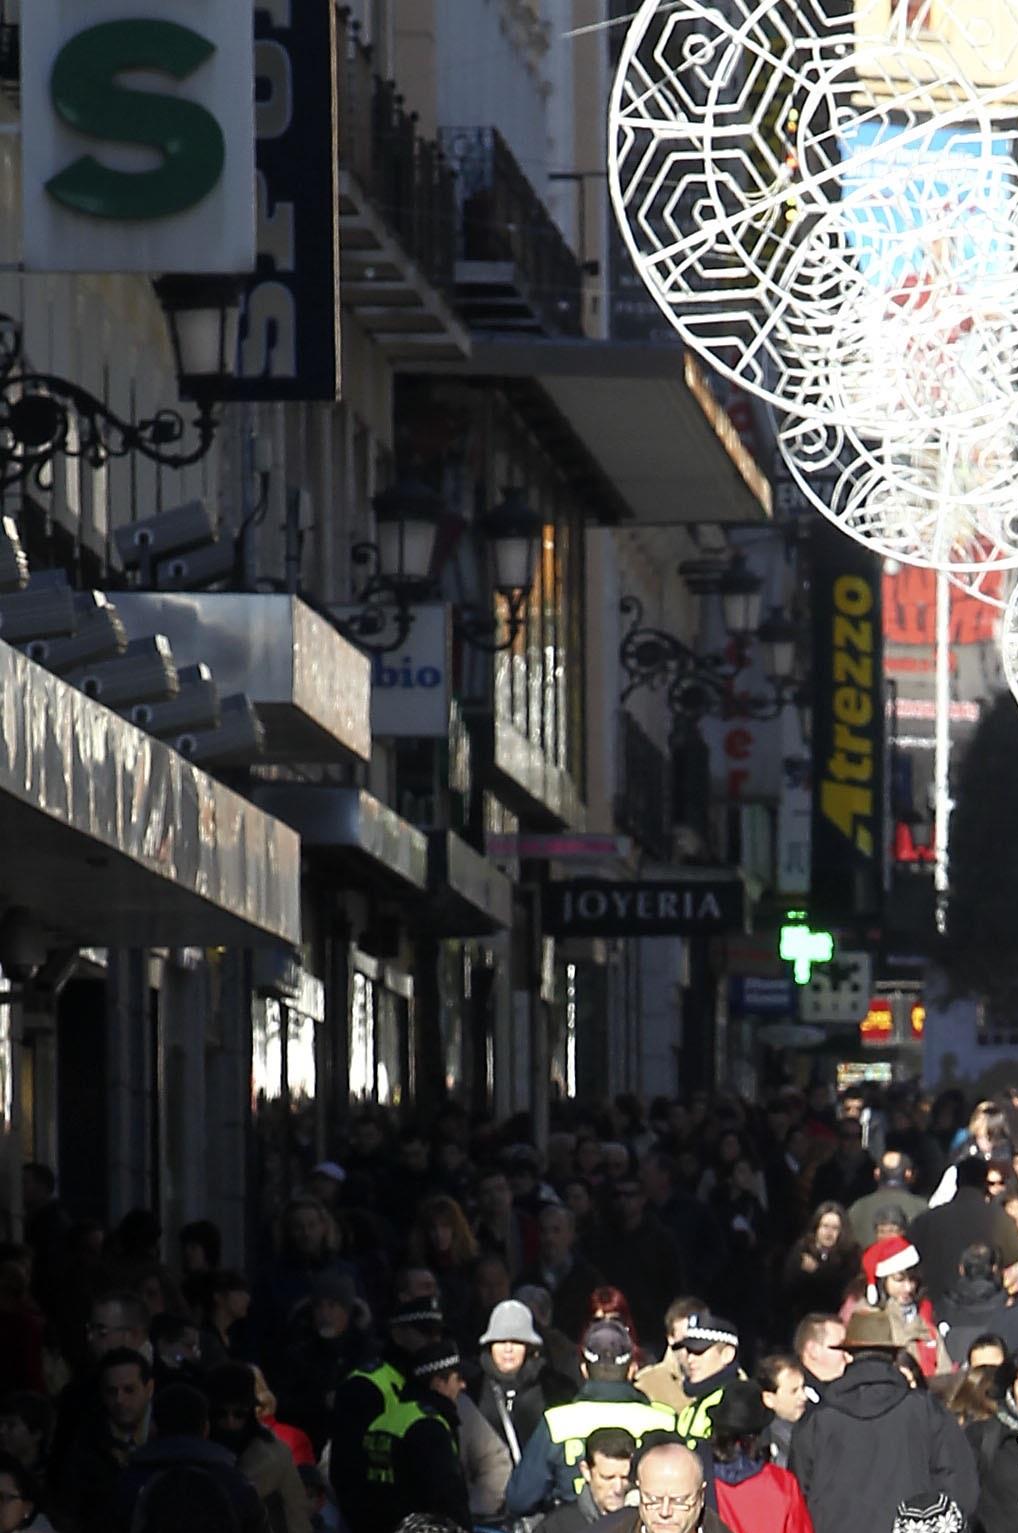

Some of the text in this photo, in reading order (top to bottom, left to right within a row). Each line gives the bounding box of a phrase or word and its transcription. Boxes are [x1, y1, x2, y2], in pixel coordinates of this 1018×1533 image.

[45, 18, 225, 220] S
[819, 575, 874, 858] Atrezzo
[562, 889, 721, 923] JOYERIA
